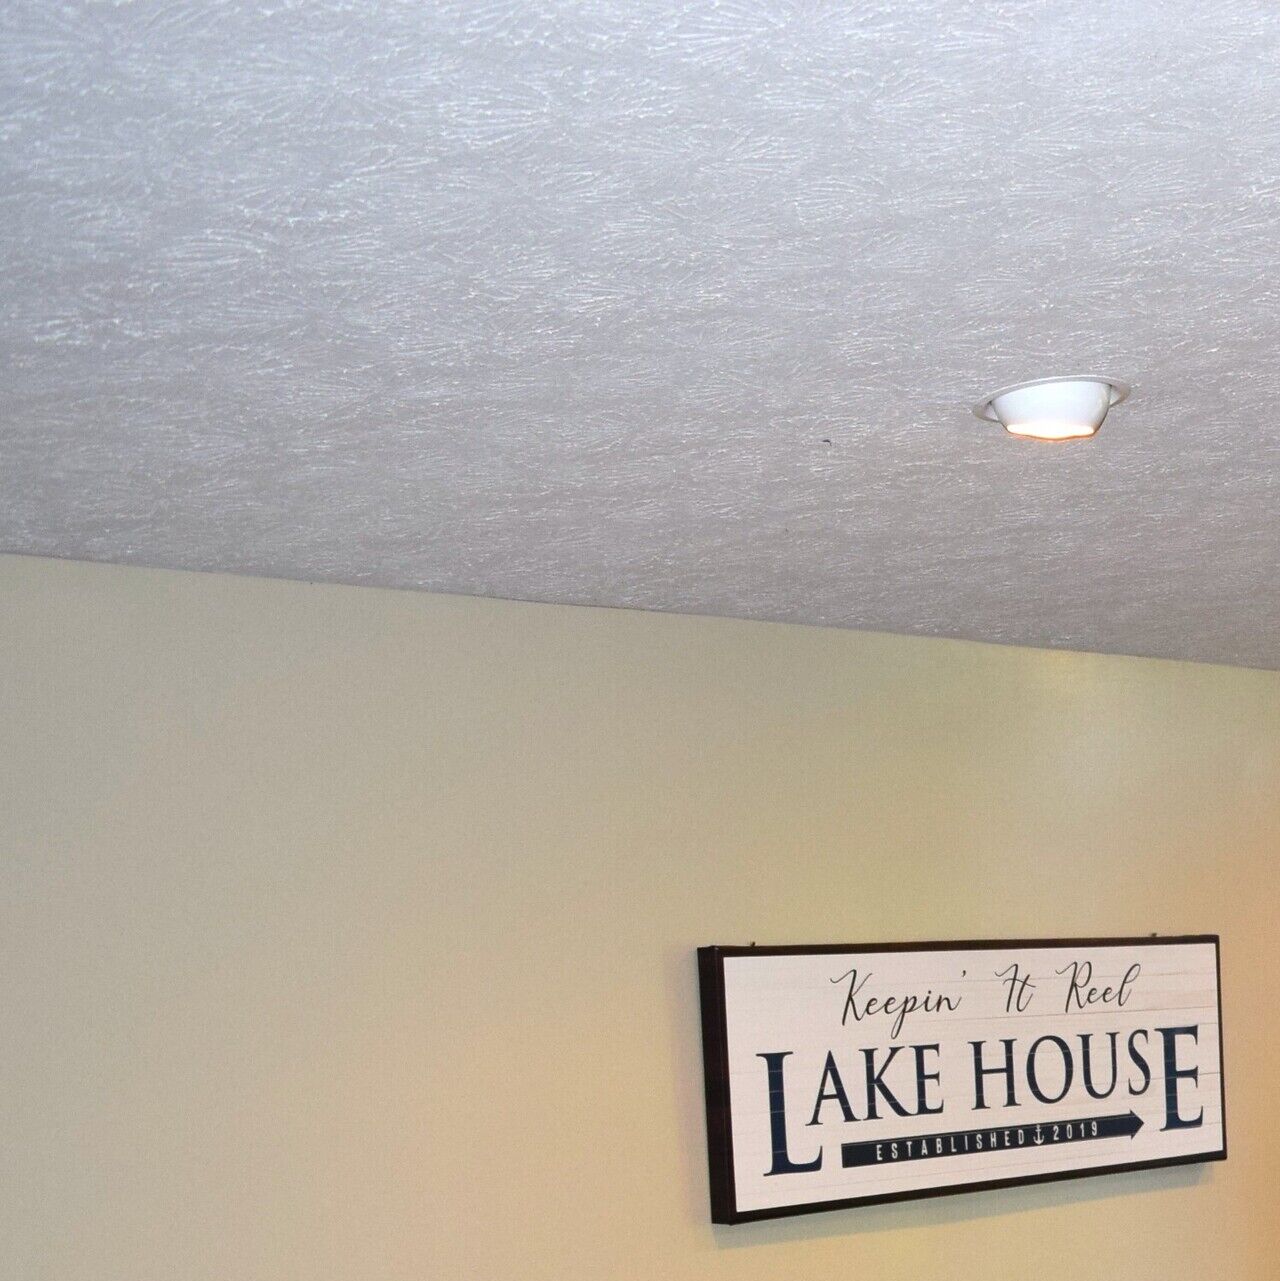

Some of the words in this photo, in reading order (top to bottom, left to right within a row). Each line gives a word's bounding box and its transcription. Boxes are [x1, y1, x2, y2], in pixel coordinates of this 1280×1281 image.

[994, 963, 1036, 1013] It
[1055, 960, 1142, 1013] Reel
[755, 1043, 944, 1176] LAKE
[967, 1024, 1204, 1132] HOUSE
[876, 1127, 1025, 1161] ESTABLISHED
[1052, 1120, 1099, 1141] 2019
